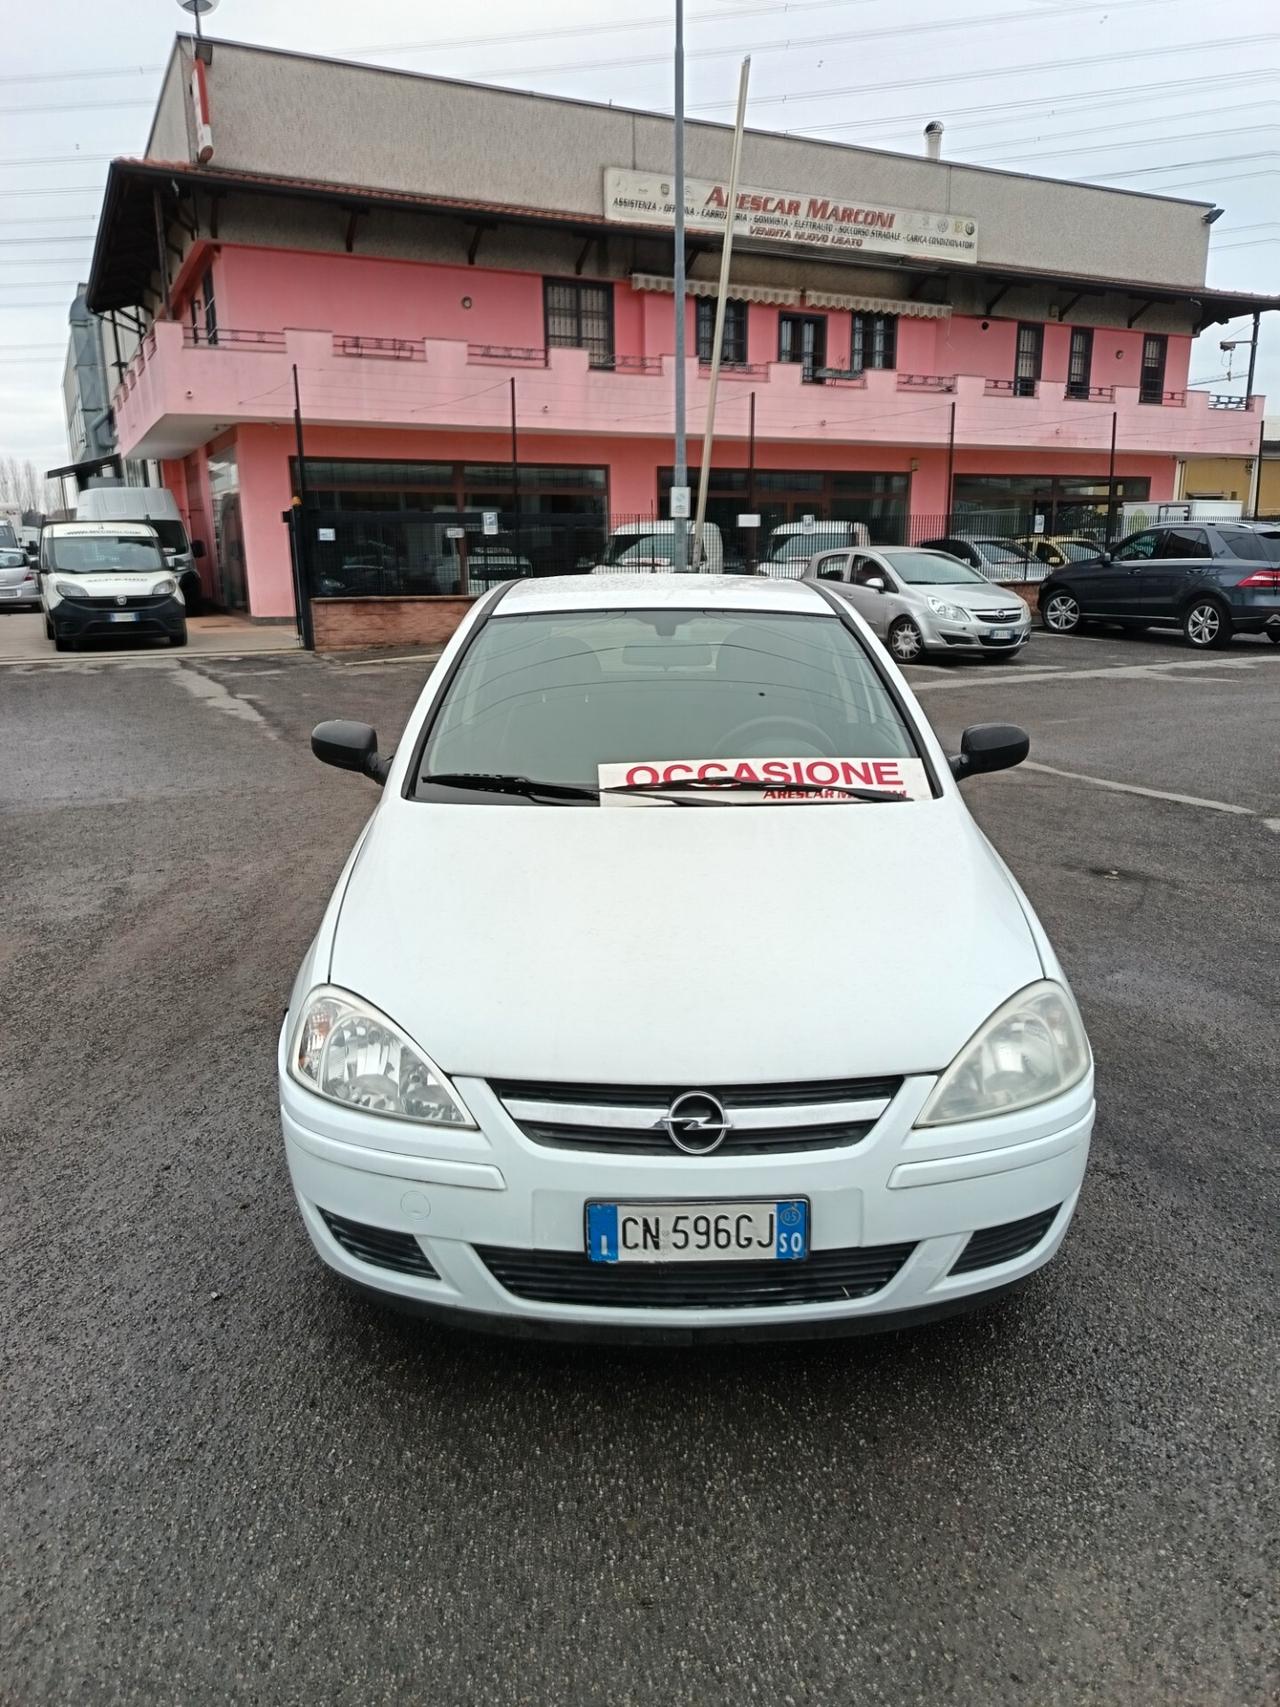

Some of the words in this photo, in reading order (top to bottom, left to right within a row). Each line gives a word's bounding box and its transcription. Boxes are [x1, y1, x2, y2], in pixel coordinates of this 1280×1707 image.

[613, 197, 657, 210] ASSISTENZA
[663, 203, 695, 216] OFFNA
[701, 208, 748, 222] CARROZRIA
[753, 214, 789, 227] GOMMISTA
[793, 219, 833, 232] ELETTRAUTO
[837, 225, 869, 237] SOCCORSO
[871, 229, 901, 241] STRADALE
[906, 233, 927, 245] CARICA
[928, 236, 975, 249] CONDIZIONATORI
[807, 198, 896, 229] MARCONI
[749, 225, 792, 239] VENDITA
[794, 232, 829, 243] NUOVO
[831, 236, 863, 248] USATO
[626, 761, 904, 787] OCCASIONE
[763, 789, 835, 800] ARESCAR
[621, 1216, 660, 1250] CN
[671, 1213, 774, 1250] 596GJ
[779, 1231, 802, 1253] SO
